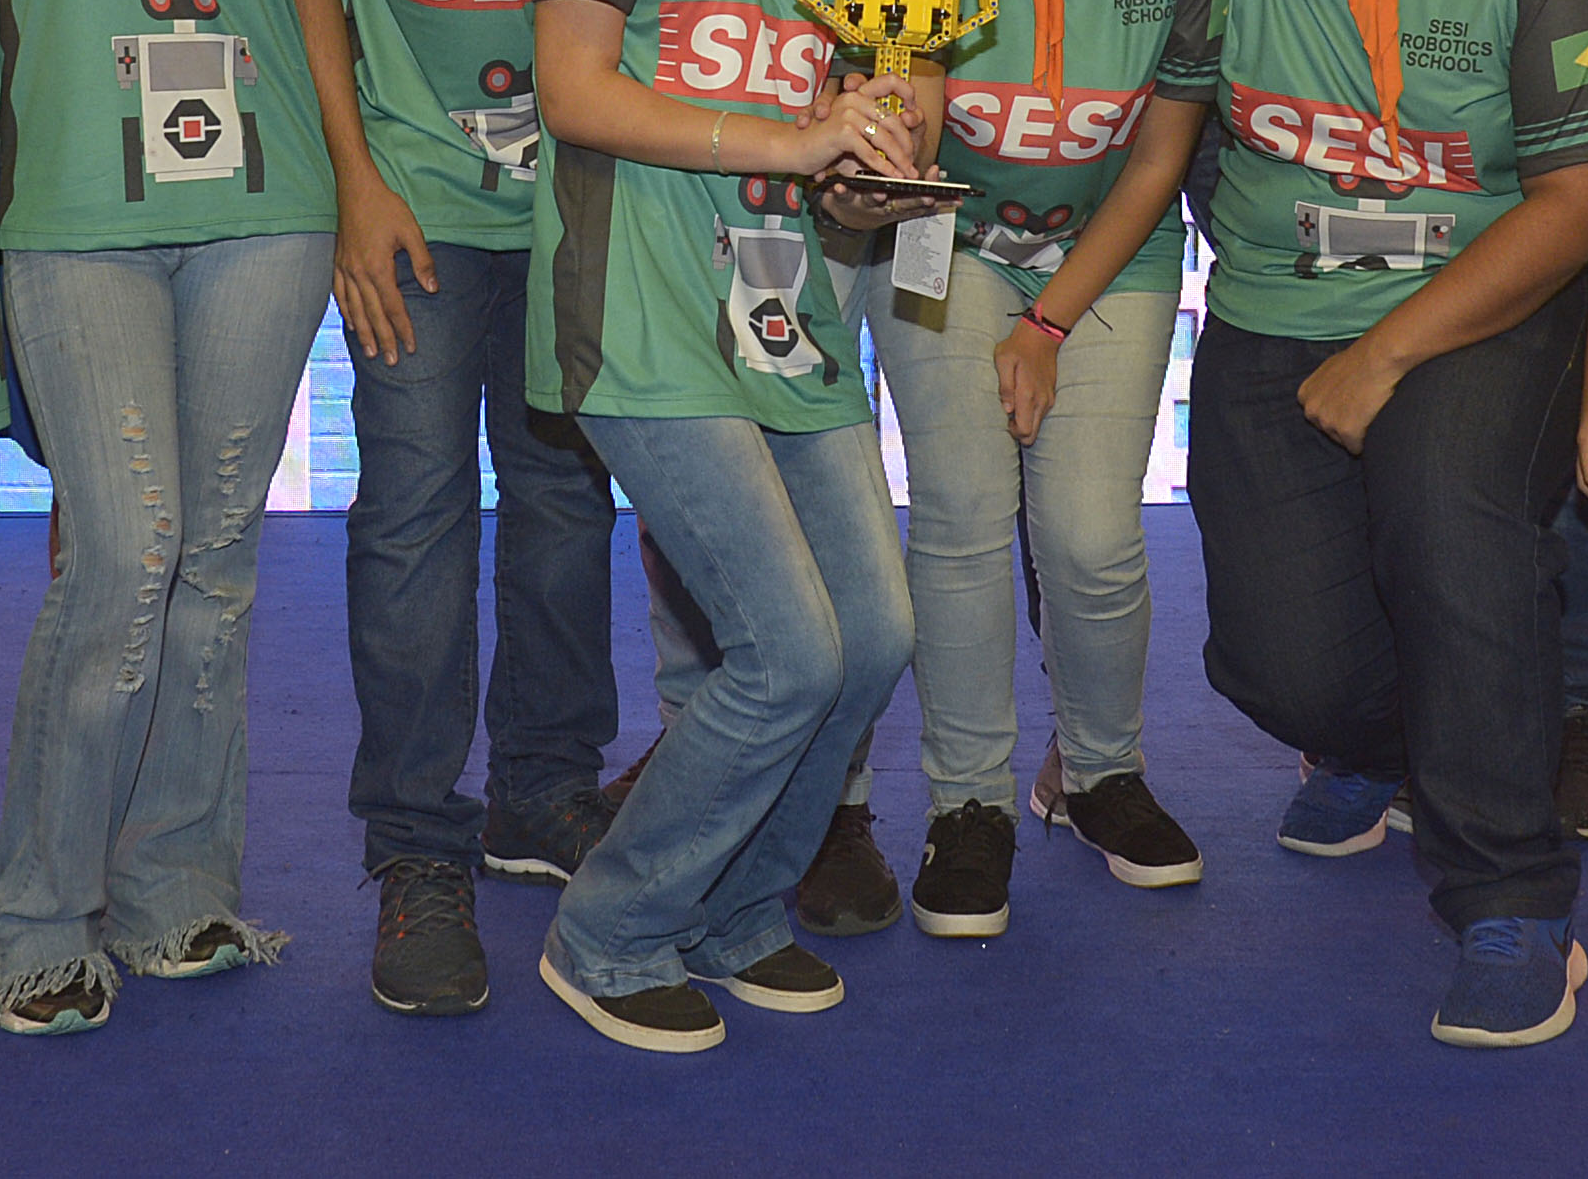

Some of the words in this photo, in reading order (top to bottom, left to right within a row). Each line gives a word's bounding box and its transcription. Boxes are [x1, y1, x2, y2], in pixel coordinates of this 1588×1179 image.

[1122, 5, 1176, 26] SCHOO
[1429, 19, 1469, 38] SESI
[1400, 32, 1493, 57] ROBOTICS
[1406, 51, 1483, 73] SCHOOL
[947, 92, 1147, 159] SESI
[1250, 104, 1447, 184] SESI
